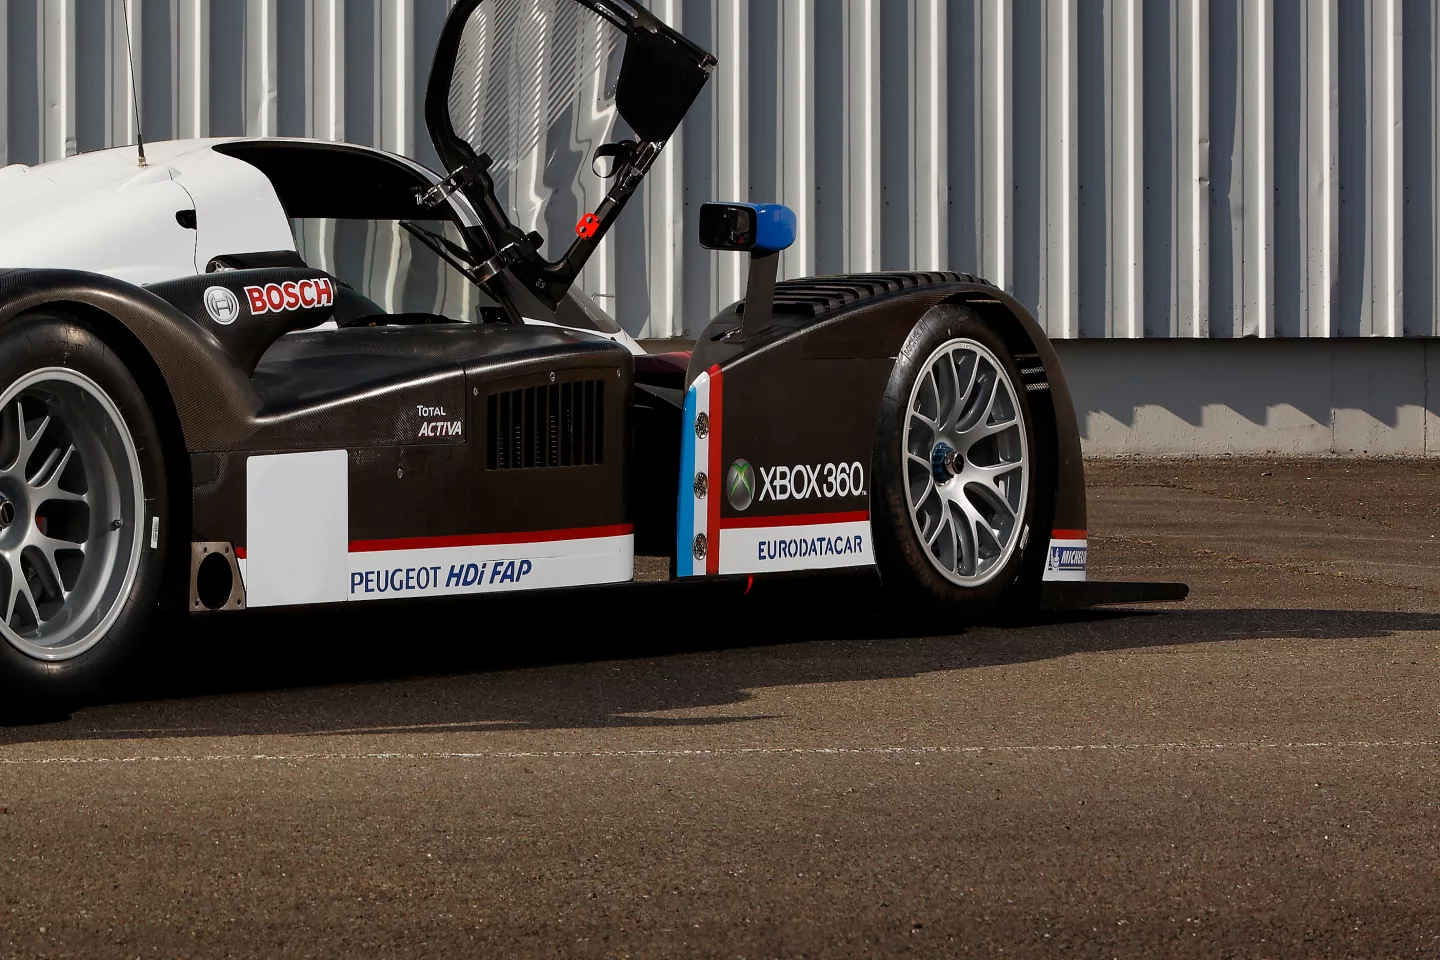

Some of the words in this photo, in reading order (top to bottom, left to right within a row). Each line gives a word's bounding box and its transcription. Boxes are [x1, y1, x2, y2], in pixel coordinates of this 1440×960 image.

[244, 278, 333, 315] BOSCH
[418, 420, 462, 437] ACTIVA
[758, 463, 822, 502] XBOX
[758, 535, 863, 561] EURODATACAR
[350, 566, 442, 595] PEUGEOT
[445, 562, 486, 588] HDi
[488, 558, 533, 585] FAP
